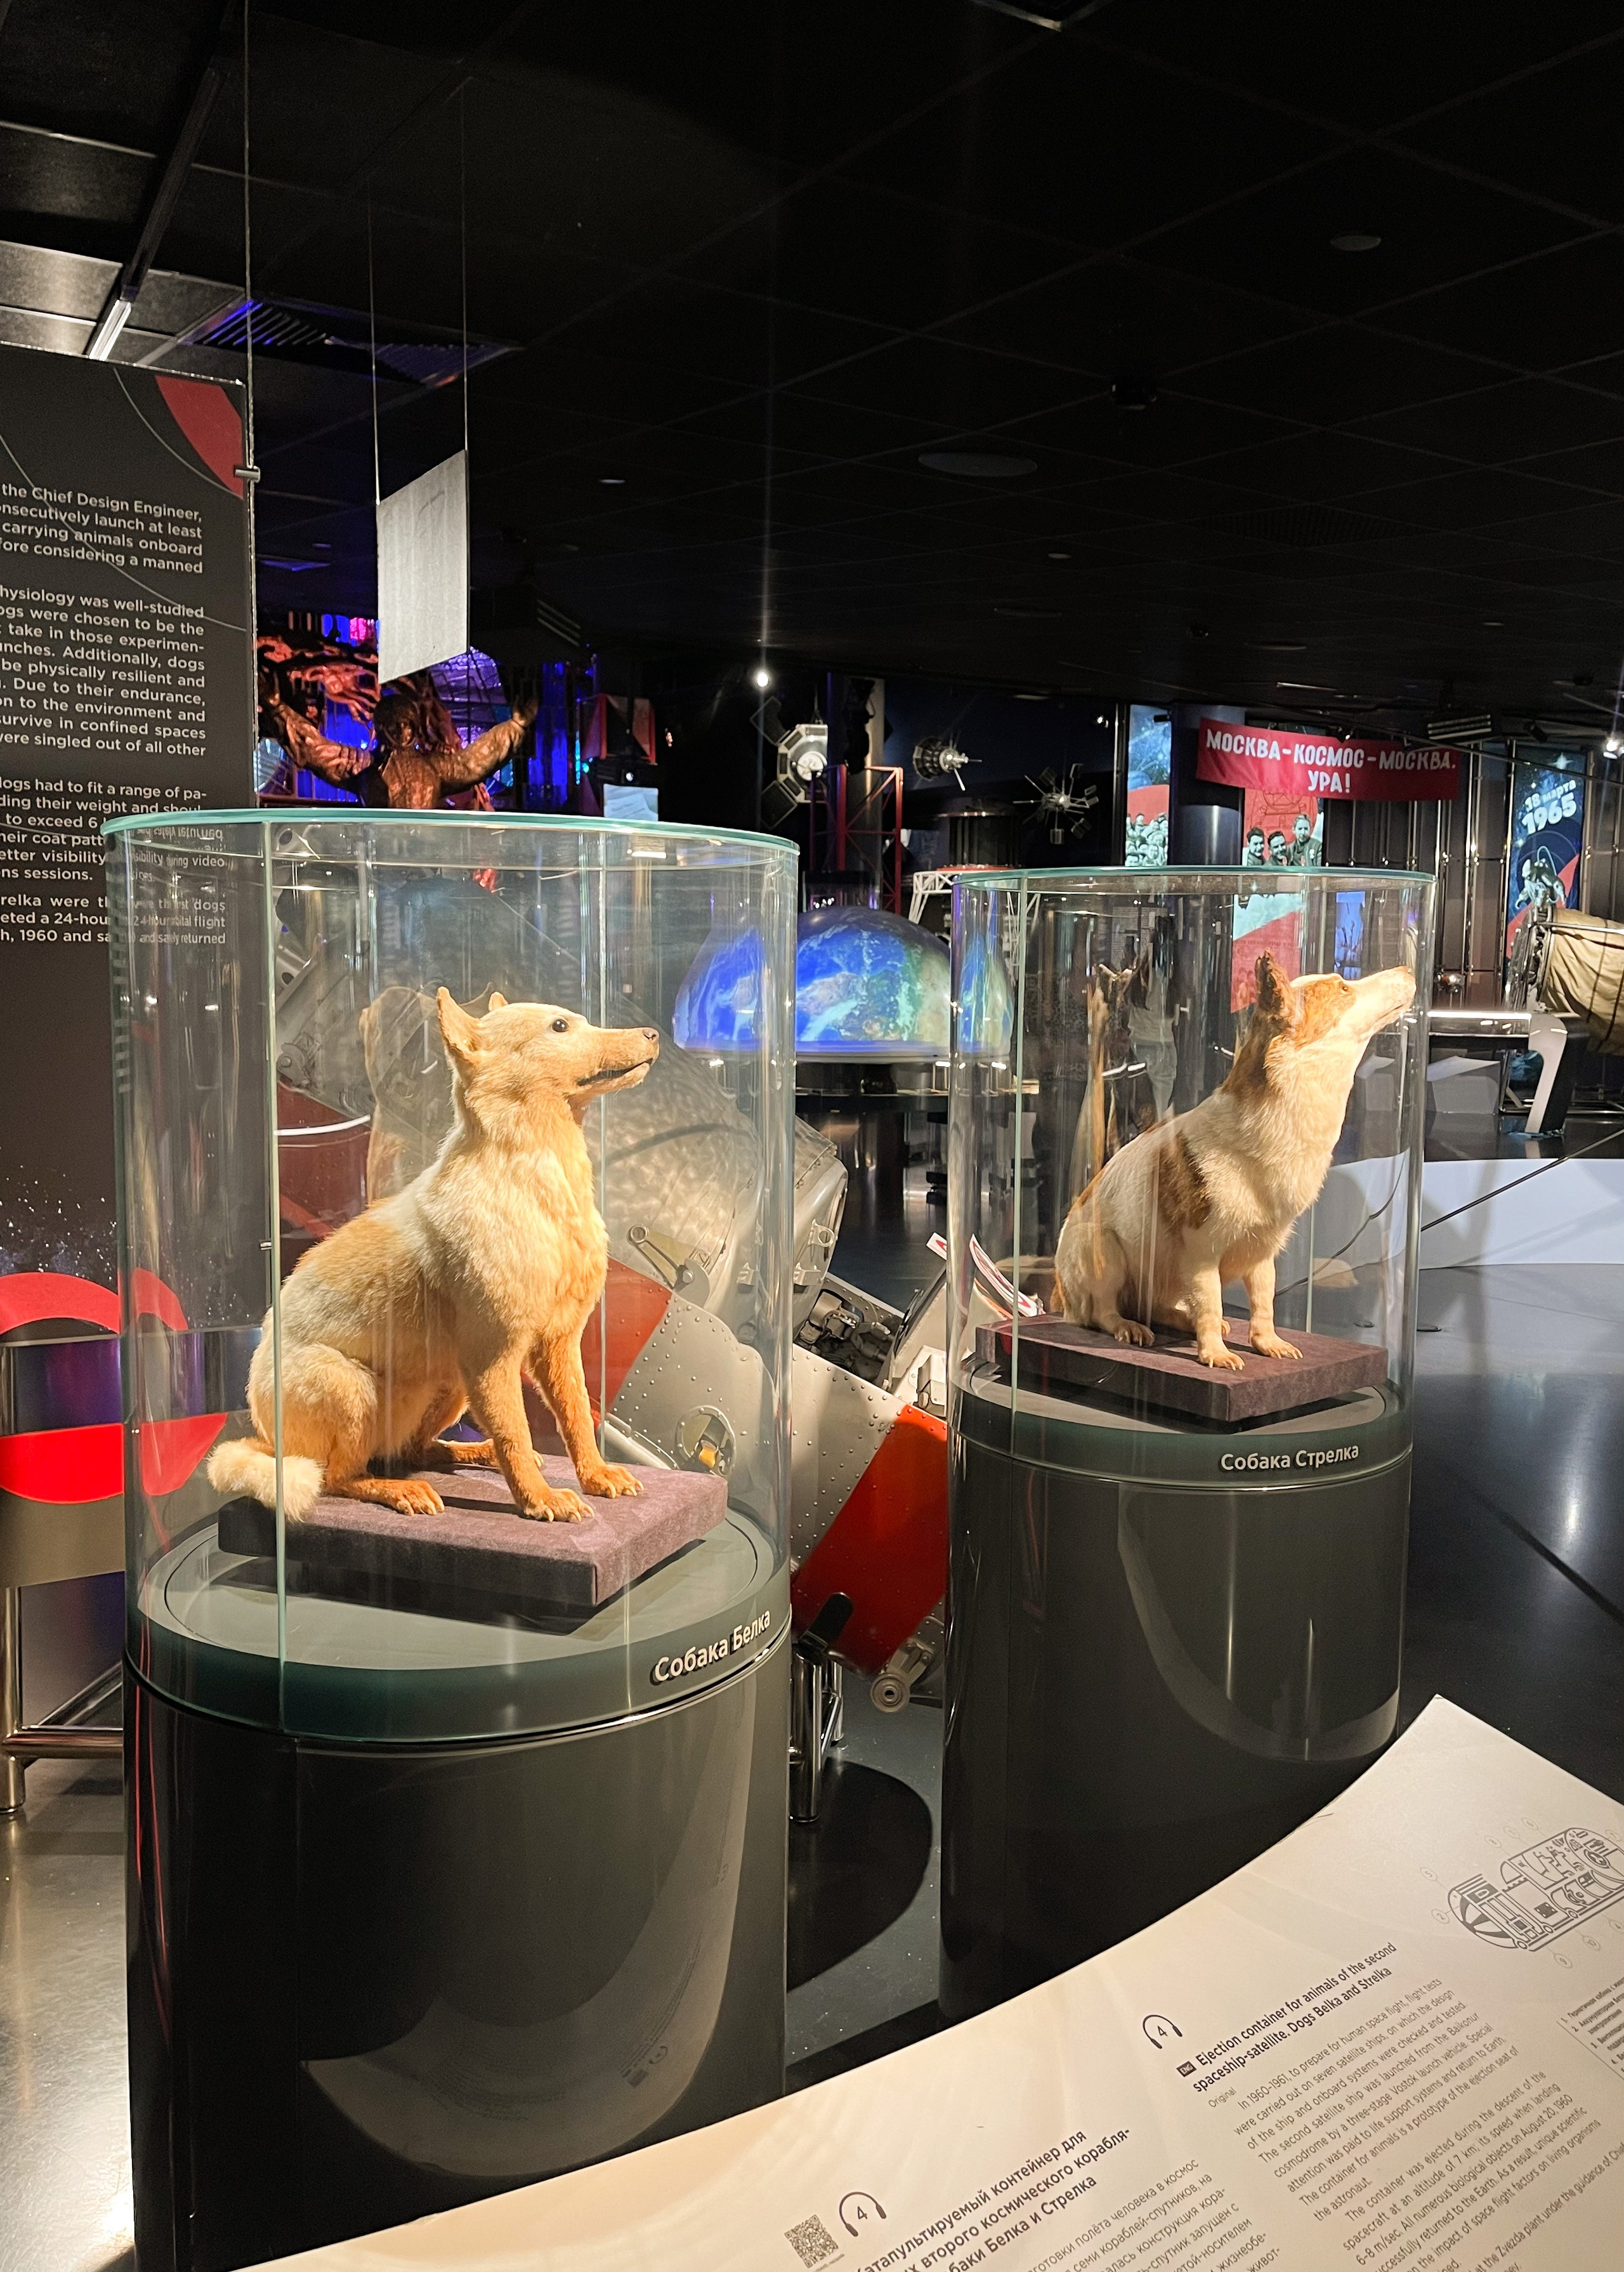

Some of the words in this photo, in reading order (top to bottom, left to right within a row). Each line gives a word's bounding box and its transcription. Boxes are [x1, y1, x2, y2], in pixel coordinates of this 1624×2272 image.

[2, 483, 28, 499] the
[32, 487, 74, 504] Chief
[77, 494, 130, 512] Design
[134, 501, 203, 523] Engineer,
[2, 522, 70, 542] carrying
[75, 530, 134, 548] animals
[138, 538, 202, 556] onboard
[95, 512, 144, 531] launch
[148, 522, 163, 534] at
[167, 522, 202, 539] least
[34, 545, 126, 567] considering
[129, 556, 138, 565] a
[143, 557, 202, 574] manned
[79, 596, 109, 608] was
[114, 598, 204, 619] well-studied
[30, 608, 68, 622] were
[74, 612, 129, 628] chosen
[134, 617, 150, 629] to
[156, 619, 174, 633] be
[180, 622, 204, 636] the
[8, 622, 43, 637] take
[49, 626, 63, 640] in
[70, 628, 113, 644] those
[119, 636, 204, 652] experimen-
[1, 657, 22, 671] be
[28, 660, 105, 681] physically
[112, 669, 172, 685] resilient
[178, 676, 204, 688] and
[62, 646, 161, 668] Additionally,
[167, 655, 204, 671] dogs
[13, 677, 46, 692] Due
[53, 681, 70, 693] to
[76, 682, 114, 697] their
[121, 688, 205, 707] endurance,
[19, 696, 36, 709] to
[43, 697, 69, 711] the
[75, 702, 172, 719] environment
[178, 710, 205, 722] and
[59, 716, 73, 730] in
[80, 719, 148, 735] confined
[155, 726, 206, 739] spaces
[34, 733, 90, 749] singled
[95, 739, 121, 750] out
[126, 739, 141, 751] of
[145, 740, 162, 753] all
[166, 742, 206, 756] other
[35, 778, 63, 792] had
[67, 781, 83, 792] to
[88, 781, 103, 794] fit
[107, 785, 115, 794] a
[120, 786, 161, 799] range
[164, 786, 180, 798] of
[183, 789, 207, 801] pa-
[1307, 770, 1351, 794] УРА!
[36, 796, 72, 810] their
[75, 799, 127, 814] weight
[131, 803, 159, 815] and
[1521, 792, 1578, 836] 1965
[1524, 793, 1542, 813] 18
[6, 813, 23, 825] to
[27, 815, 82, 827] exceed
[88, 817, 98, 829] 6
[32, 833, 67, 846] coat
[42, 850, 108, 865] visibility
[192, 855, 226, 868] video
[24, 867, 93, 881] sessions.
[50, 897, 89, 907] were
[193, 899, 226, 914] dogs
[40, 914, 49, 924] a
[194, 916, 226, 929] flight
[19, 929, 57, 941] 1960
[63, 929, 91, 942] and
[180, 933, 226, 944] returned
[1221, 1453, 1292, 1471] Собака
[1295, 1445, 1359, 1468] Стрелка
[655, 1639, 729, 1683] Собака
[733, 1610, 771, 1651] Белка
[1195, 2036, 1241, 2065] Ejection
[1241, 2007, 1287, 2039] container
[1285, 1999, 1302, 2011] for
[1302, 1978, 1339, 2002] animals
[1338, 1969, 1349, 1980] of
[1347, 1962, 1365, 1974] the
[1365, 1942, 1396, 1965] second
[1157, 2026, 1169, 2037] 4
[1193, 2032, 1290, 2092] spaceship-satellite.
[1287, 2014, 1316, 2032] Dogs
[1313, 1997, 1342, 2016] Belka
[1341, 1984, 1361, 2000] and
[1358, 1968, 1392, 1989] Strelka
[1238, 2101, 1250, 2110] In
[1247, 2073, 1292, 2103] 1960-1961,
[1288, 2068, 1300, 2077] to
[1299, 2049, 1330, 2072] prepare
[1327, 2041, 1341, 2051] for
[1339, 2026, 1367, 2044] human
[1366, 2013, 1387, 2028] space
[1385, 2000, 1408, 2015] flight,
[1405, 1988, 1426, 2002] flight
[1423, 1979, 1441, 1991] tests
[1233, 2118, 1256, 2134] were
[1257, 2096, 1286, 2120] carried
[1287, 2087, 1302, 2101] out
[1302, 2081, 1314, 2091] on
[1313, 2066, 1337, 2083] seven
[1336, 2047, 1366, 2068] satellite
[1387, 2026, 1398, 2035] on
[1397, 2012, 1420, 2028] which
[1417, 2005, 1432, 2014] the
[1431, 1990, 1455, 2006] design
[1208, 2087, 1236, 2107] Original
[1343, 2212, 1389, 2250] spacecraft
[1389, 2203, 1401, 2214] at
[1401, 2195, 1413, 2206] an
[1413, 2170, 1445, 2196] altitude
[1446, 2160, 1455, 2171] of
[1453, 2155, 1462, 2164] 7
[1478, 2136, 1490, 2146] its
[1490, 2116, 1513, 2137] speed
[1512, 2103, 1533, 2120] when
[1530, 2084, 1561, 2105] landing
[858, 2190, 990, 2272] атапультируемый
[990, 2148, 1060, 2196] контейнер
[1061, 2131, 1086, 2153] для
[920, 2226, 979, 2268] второго
[980, 2165, 1073, 2229] космического
[1074, 2129, 1129, 2168] корабля-
[1075, 2219, 1111, 2247] полёта
[1111, 2188, 1156, 2219] человека
[1163, 2160, 1198, 2185] космос
[857, 2206, 868, 2221] 4
[984, 2221, 1030, 2252] Белка
[1030, 2212, 1041, 2224] и
[1041, 2177, 1096, 2214] Стрелка
[1074, 2251, 1099, 2272] семи
[1099, 2184, 1200, 2254] кораблей-спутников,
[1198, 2174, 1212, 2186] на
[1136, 2207, 1199, 2254] конструкция
[1199, 2189, 1224, 2209] кора-
[1189, 2209, 1231, 2241] запущен
[1217, 2233, 1266, 2272] жизнеобе-
